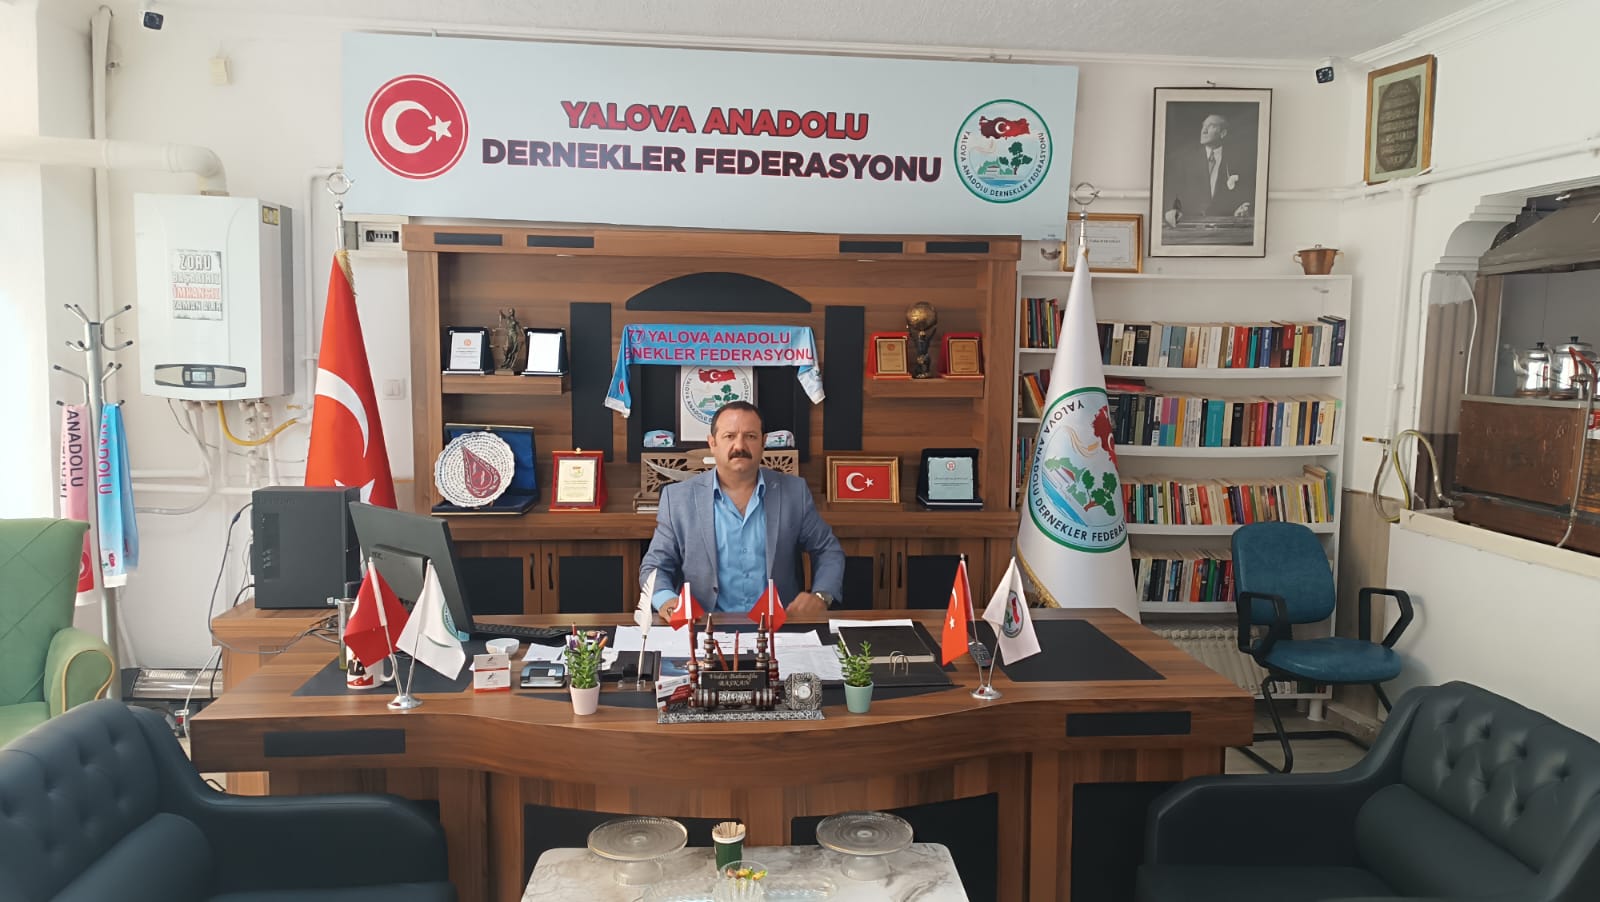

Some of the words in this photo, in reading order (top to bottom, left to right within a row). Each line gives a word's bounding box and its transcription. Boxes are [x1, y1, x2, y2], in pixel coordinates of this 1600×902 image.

[561, 101, 696, 134] YALOVA
[702, 107, 869, 140] ANADOLU
[482, 138, 686, 173] DERNEKLER
[695, 148, 942, 183] FEDERASYONU
[960, 131, 971, 162] YALOVA
[1029, 132, 1047, 185] FEDERASYONU
[962, 165, 989, 194] ANADOLU
[989, 183, 1029, 197] DERNEKLER
[179, 254, 212, 271] ZORU
[648, 330, 710, 343] YALOVA
[713, 331, 790, 344] ANADOLU
[700, 348, 814, 361] FEDERASYONU
[1043, 399, 1085, 434] YALOVA
[66, 409, 84, 487] ANADOLU
[1032, 437, 1047, 497] ANADOLU
[1034, 497, 1088, 541] DERNEKLER
